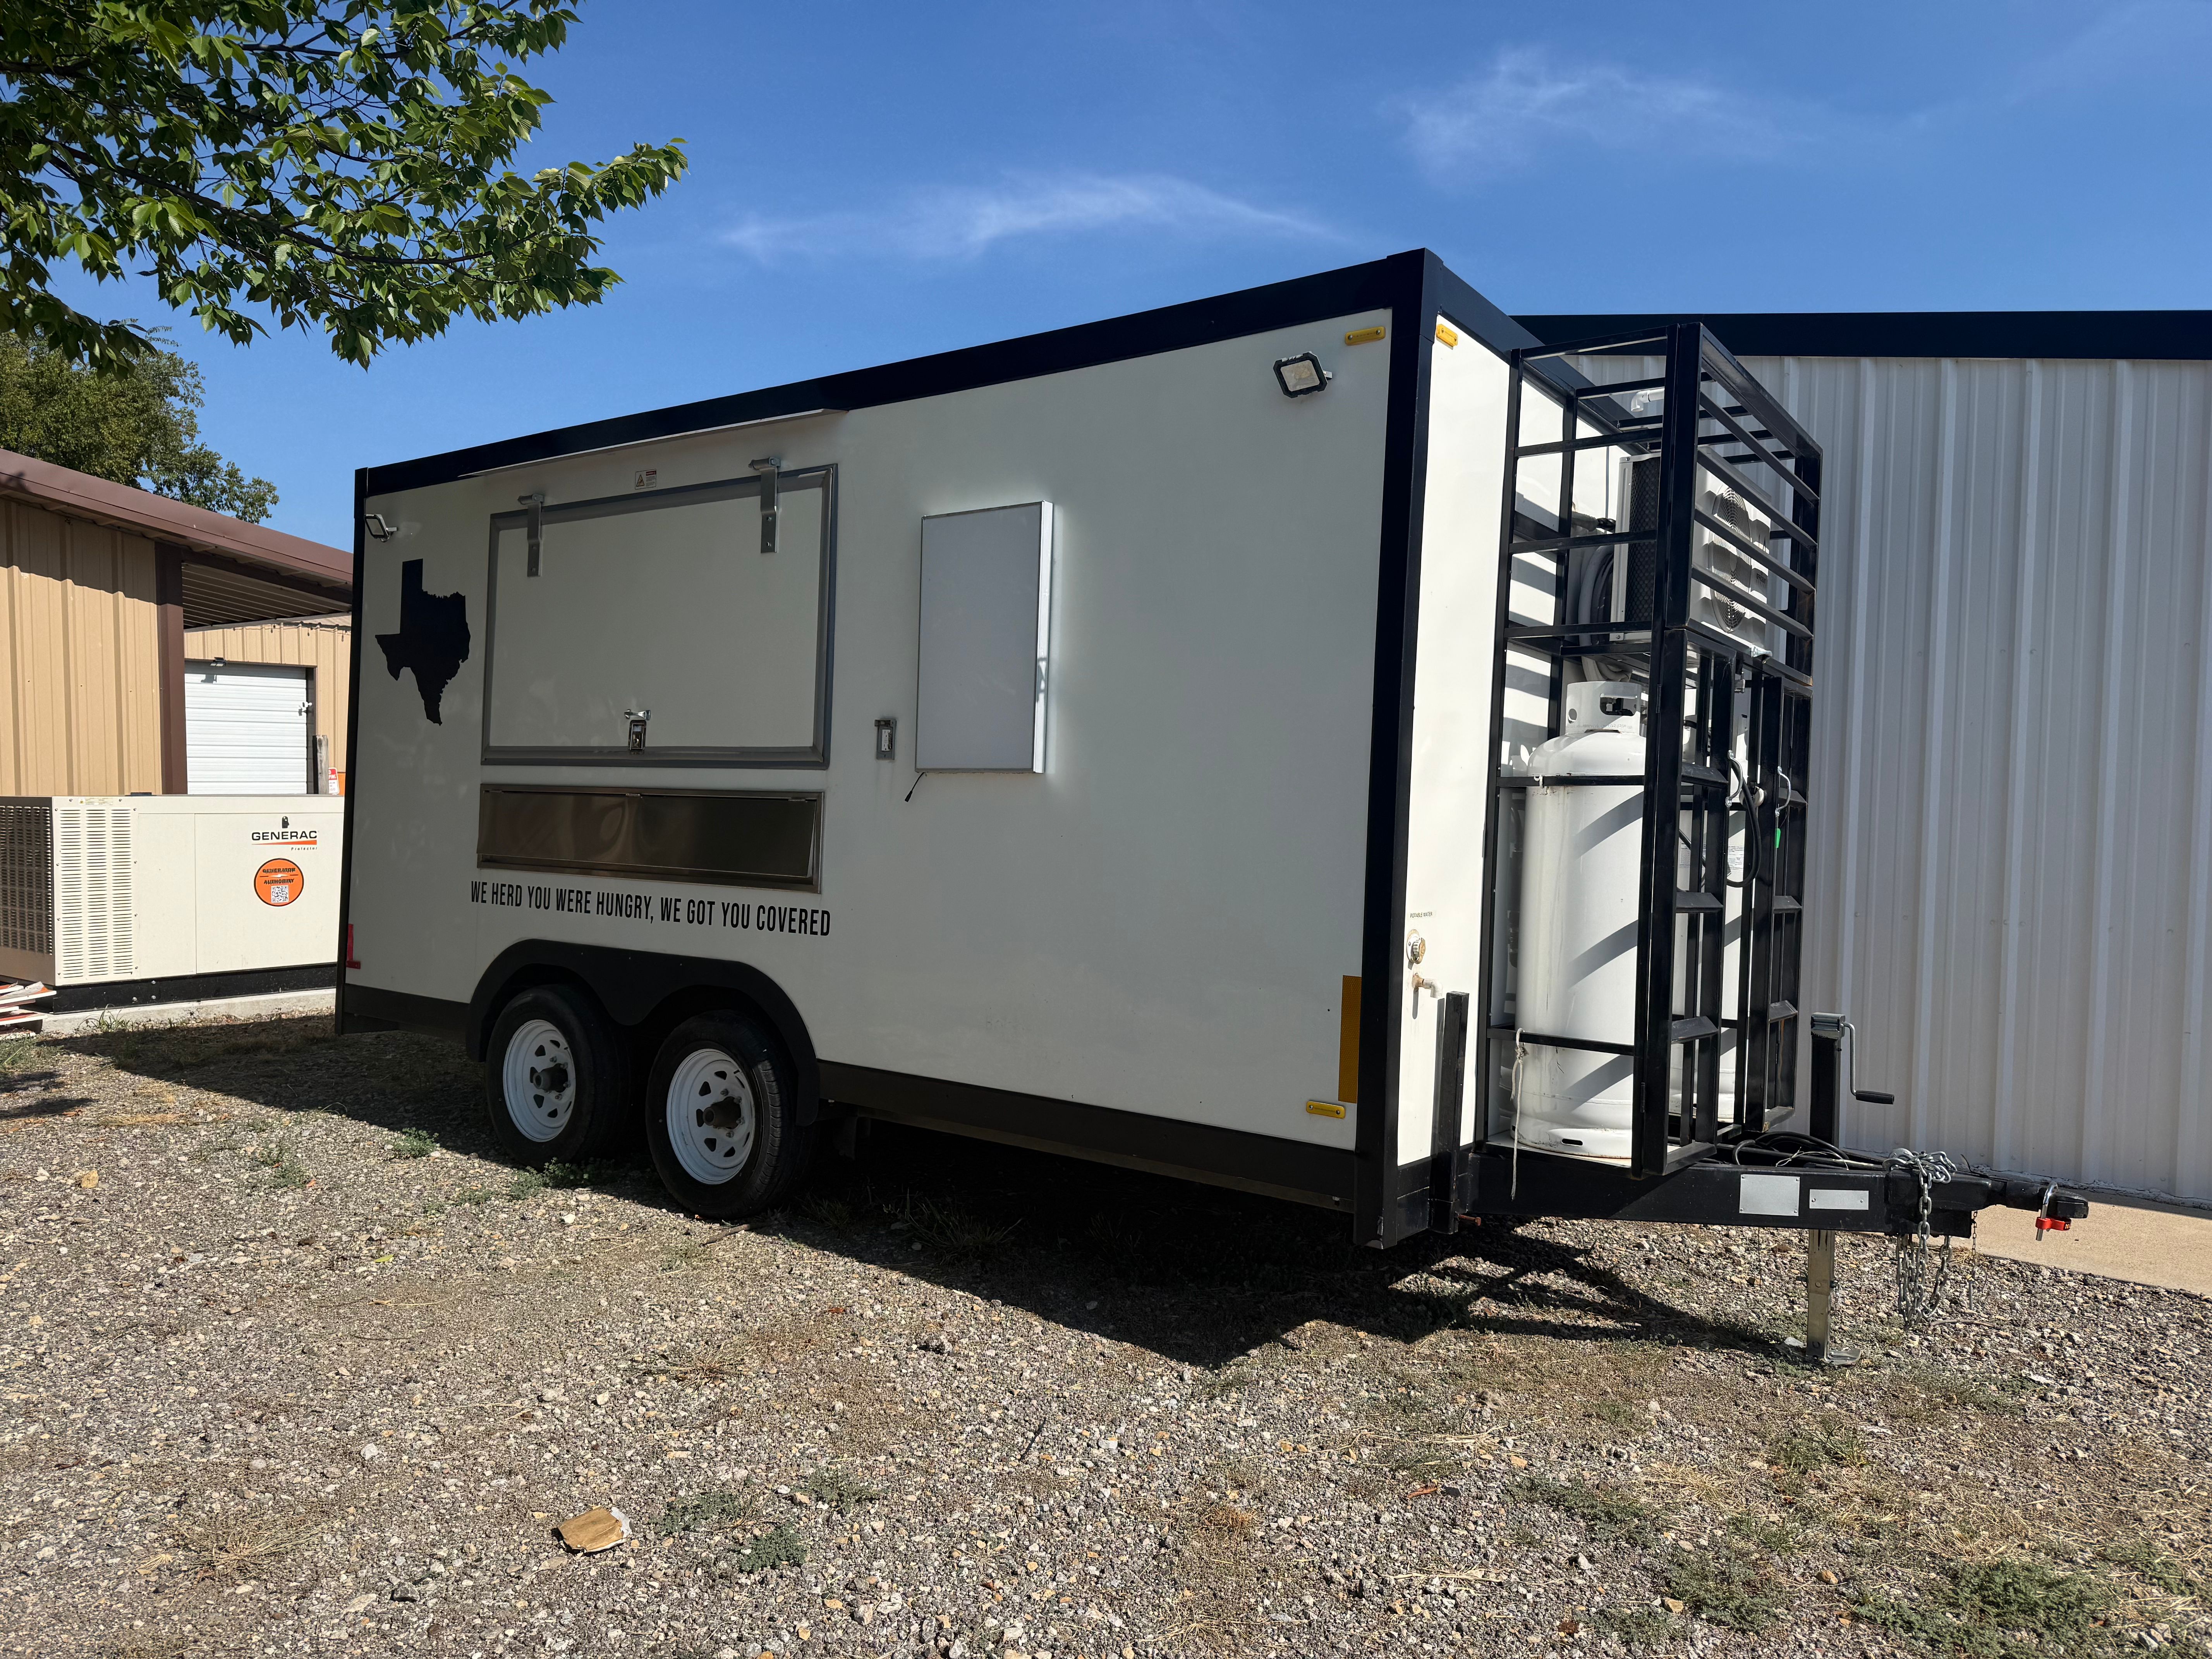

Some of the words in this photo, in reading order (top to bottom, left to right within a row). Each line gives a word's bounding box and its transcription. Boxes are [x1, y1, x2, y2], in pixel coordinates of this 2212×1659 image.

[252, 831, 317, 841] GENERAC
[471, 881, 488, 903] WE
[491, 883, 522, 907] HERD
[527, 886, 551, 910] YOU
[556, 888, 592, 914] WERE
[596, 891, 654, 924] HUNGRY,
[661, 897, 682, 922] WE
[687, 899, 715, 926] GOT
[721, 902, 750, 929] YOU
[756, 905, 830, 936] COVERED
